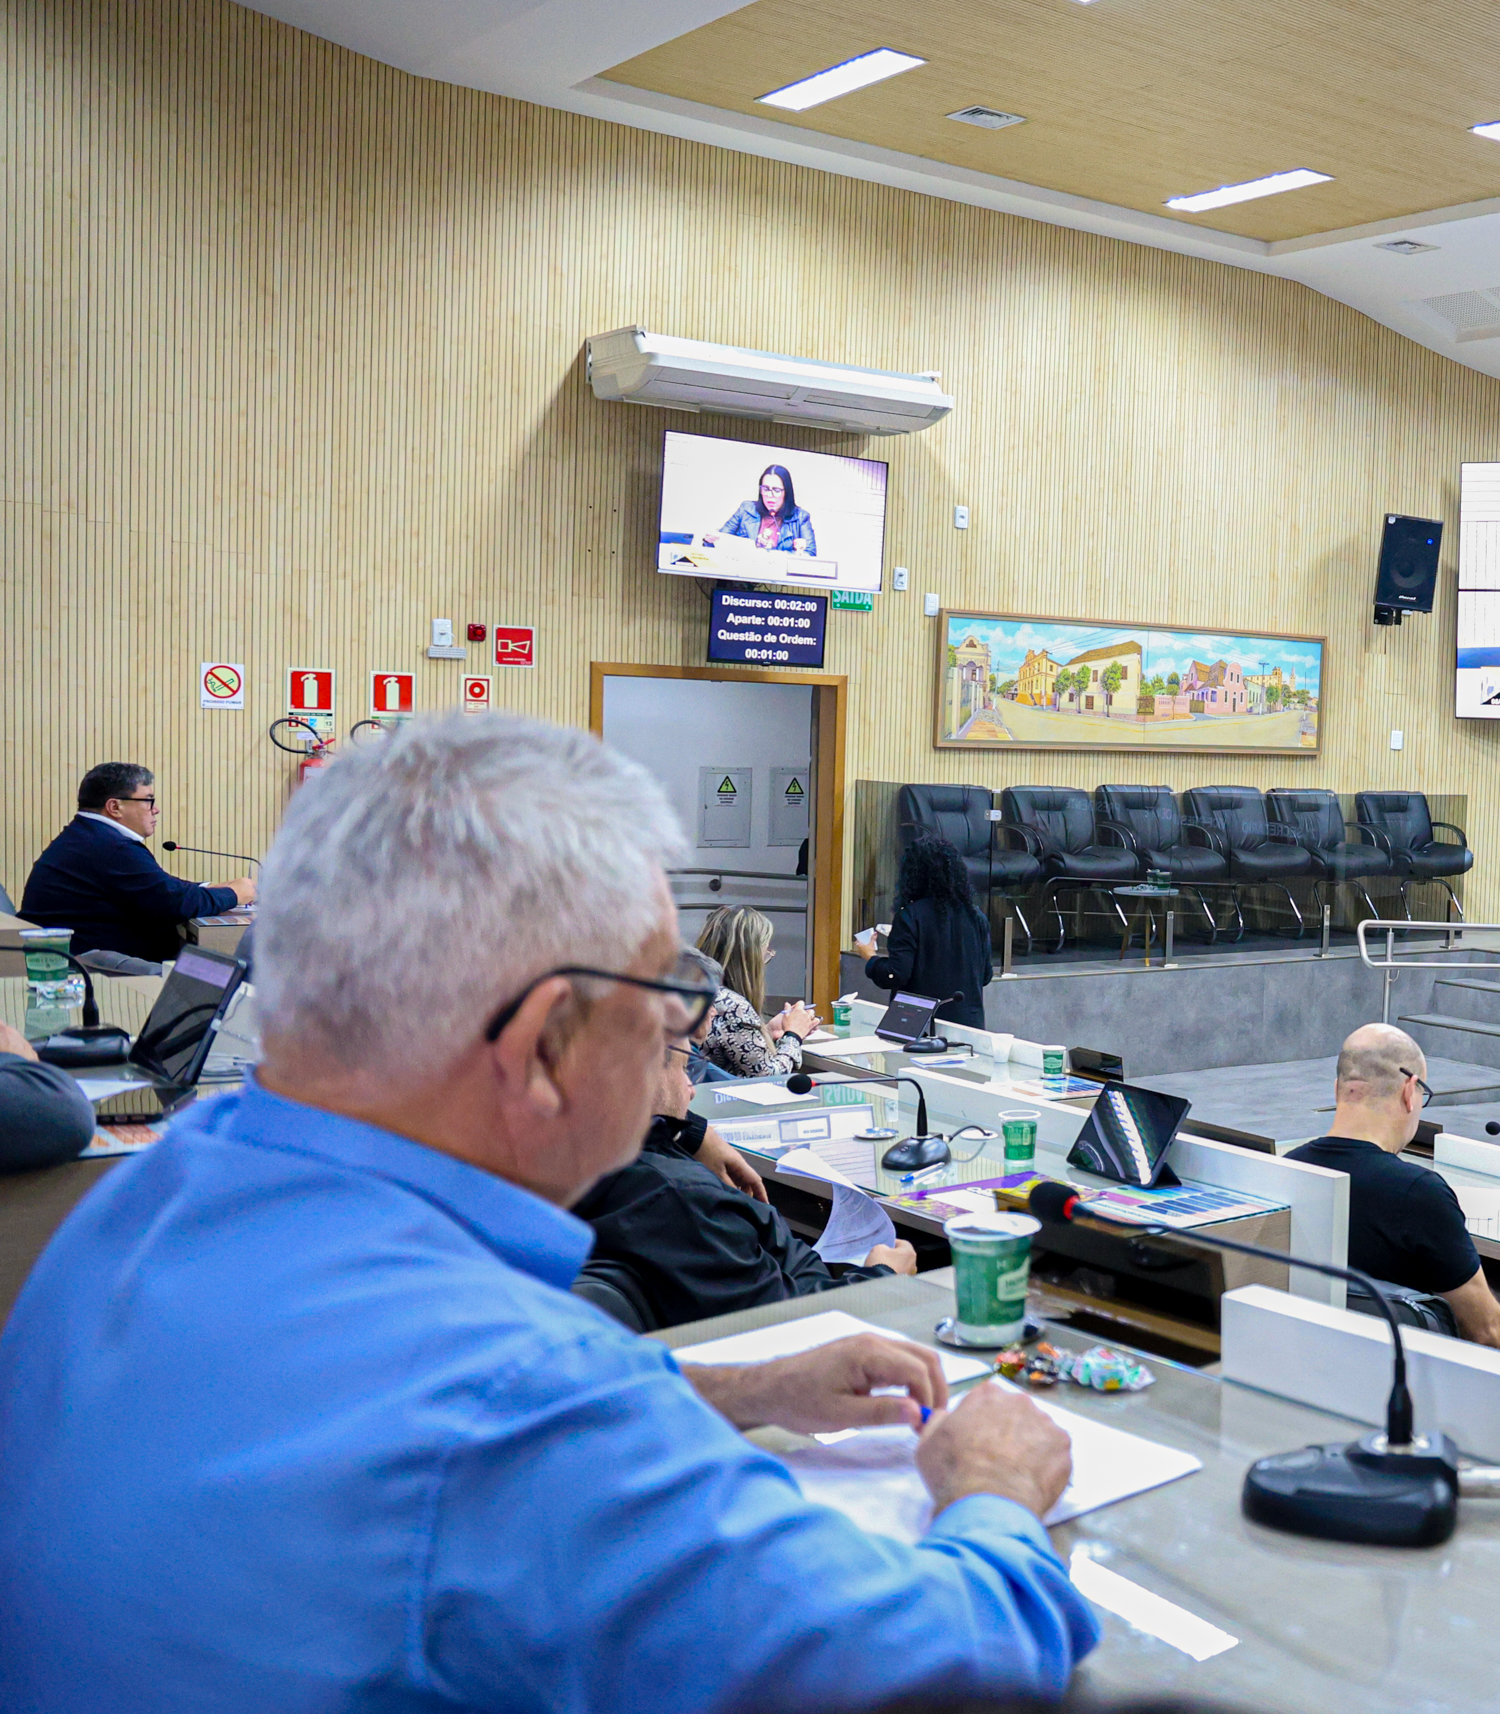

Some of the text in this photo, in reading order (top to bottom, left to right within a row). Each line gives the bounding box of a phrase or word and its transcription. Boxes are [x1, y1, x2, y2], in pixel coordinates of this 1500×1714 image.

[722, 595, 817, 612] Discurso: 00:02:00
[726, 613, 810, 628] Aparte: 00:01:00
[717, 629, 817, 645] Questão de Ordem:
[745, 648, 789, 660] 00:01:00
